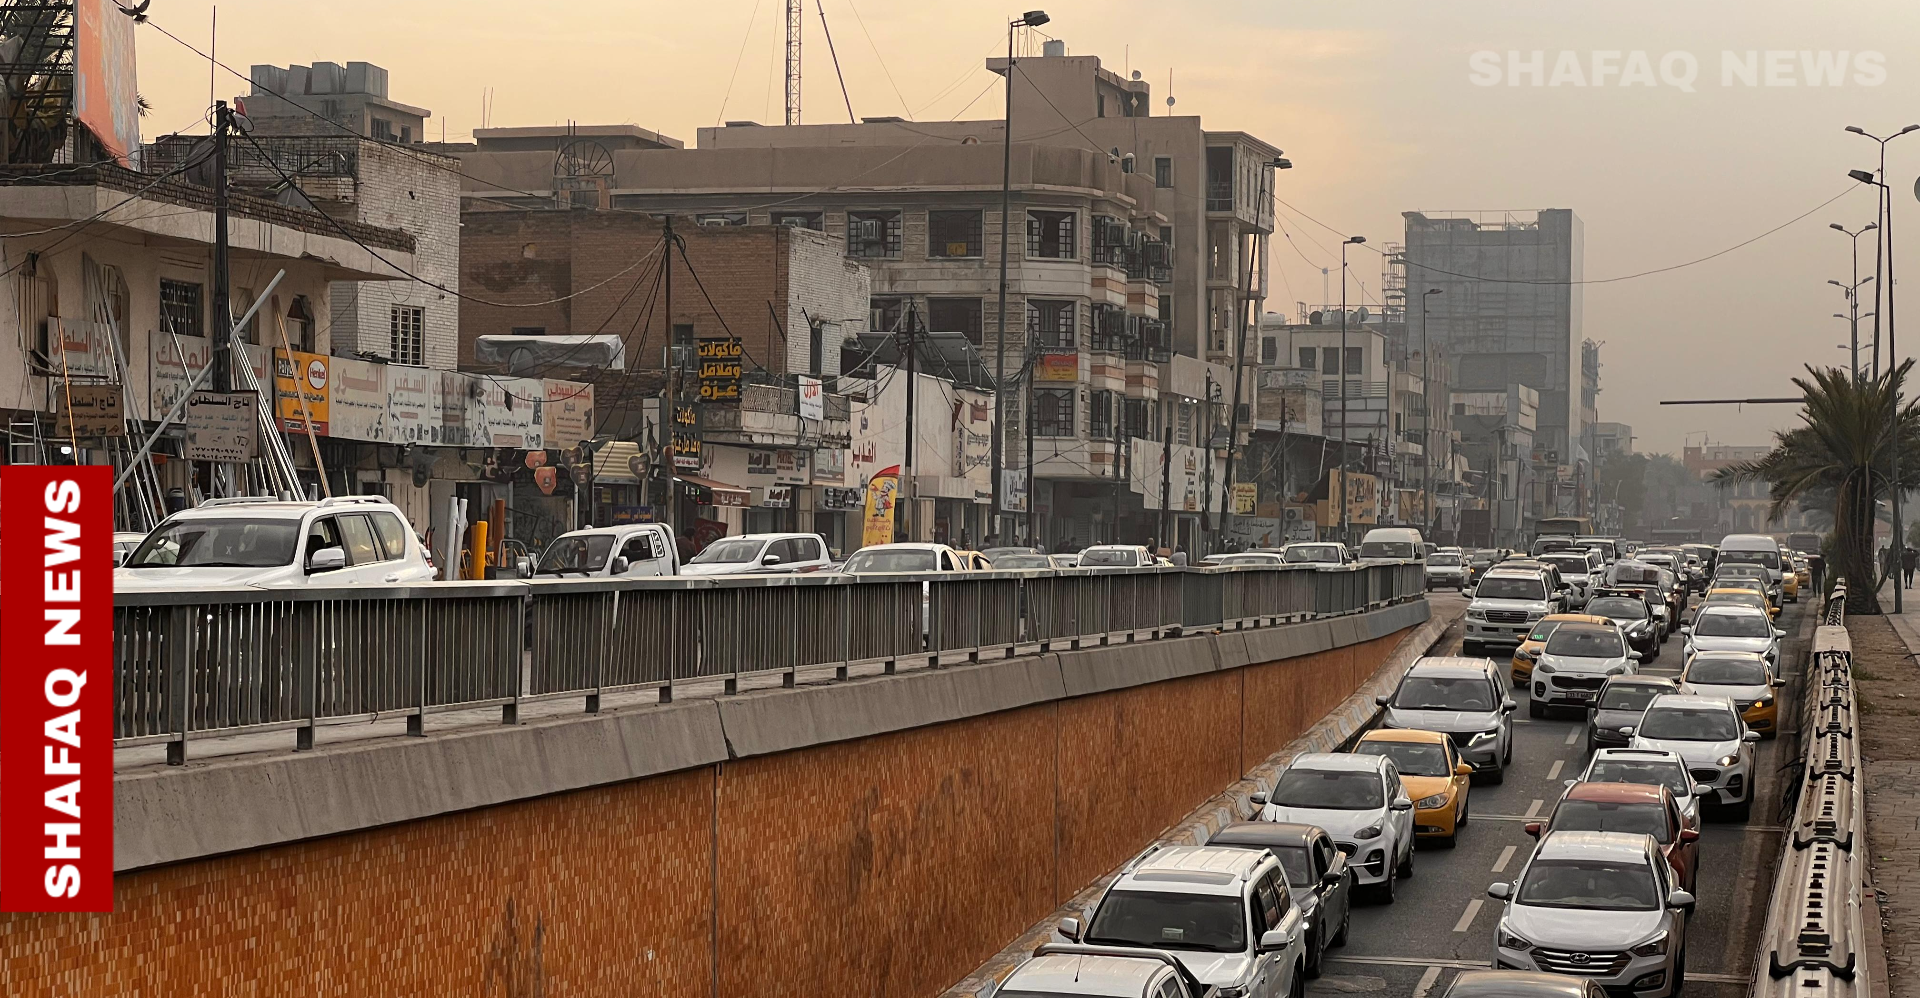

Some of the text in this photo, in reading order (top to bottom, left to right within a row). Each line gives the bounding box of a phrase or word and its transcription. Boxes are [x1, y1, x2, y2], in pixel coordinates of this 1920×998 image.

[698, 340, 742, 359] مأكولات
[698, 362, 741, 380] وفلافل
[700, 379, 738, 400] غزة
[189, 394, 231, 407] السلطان
